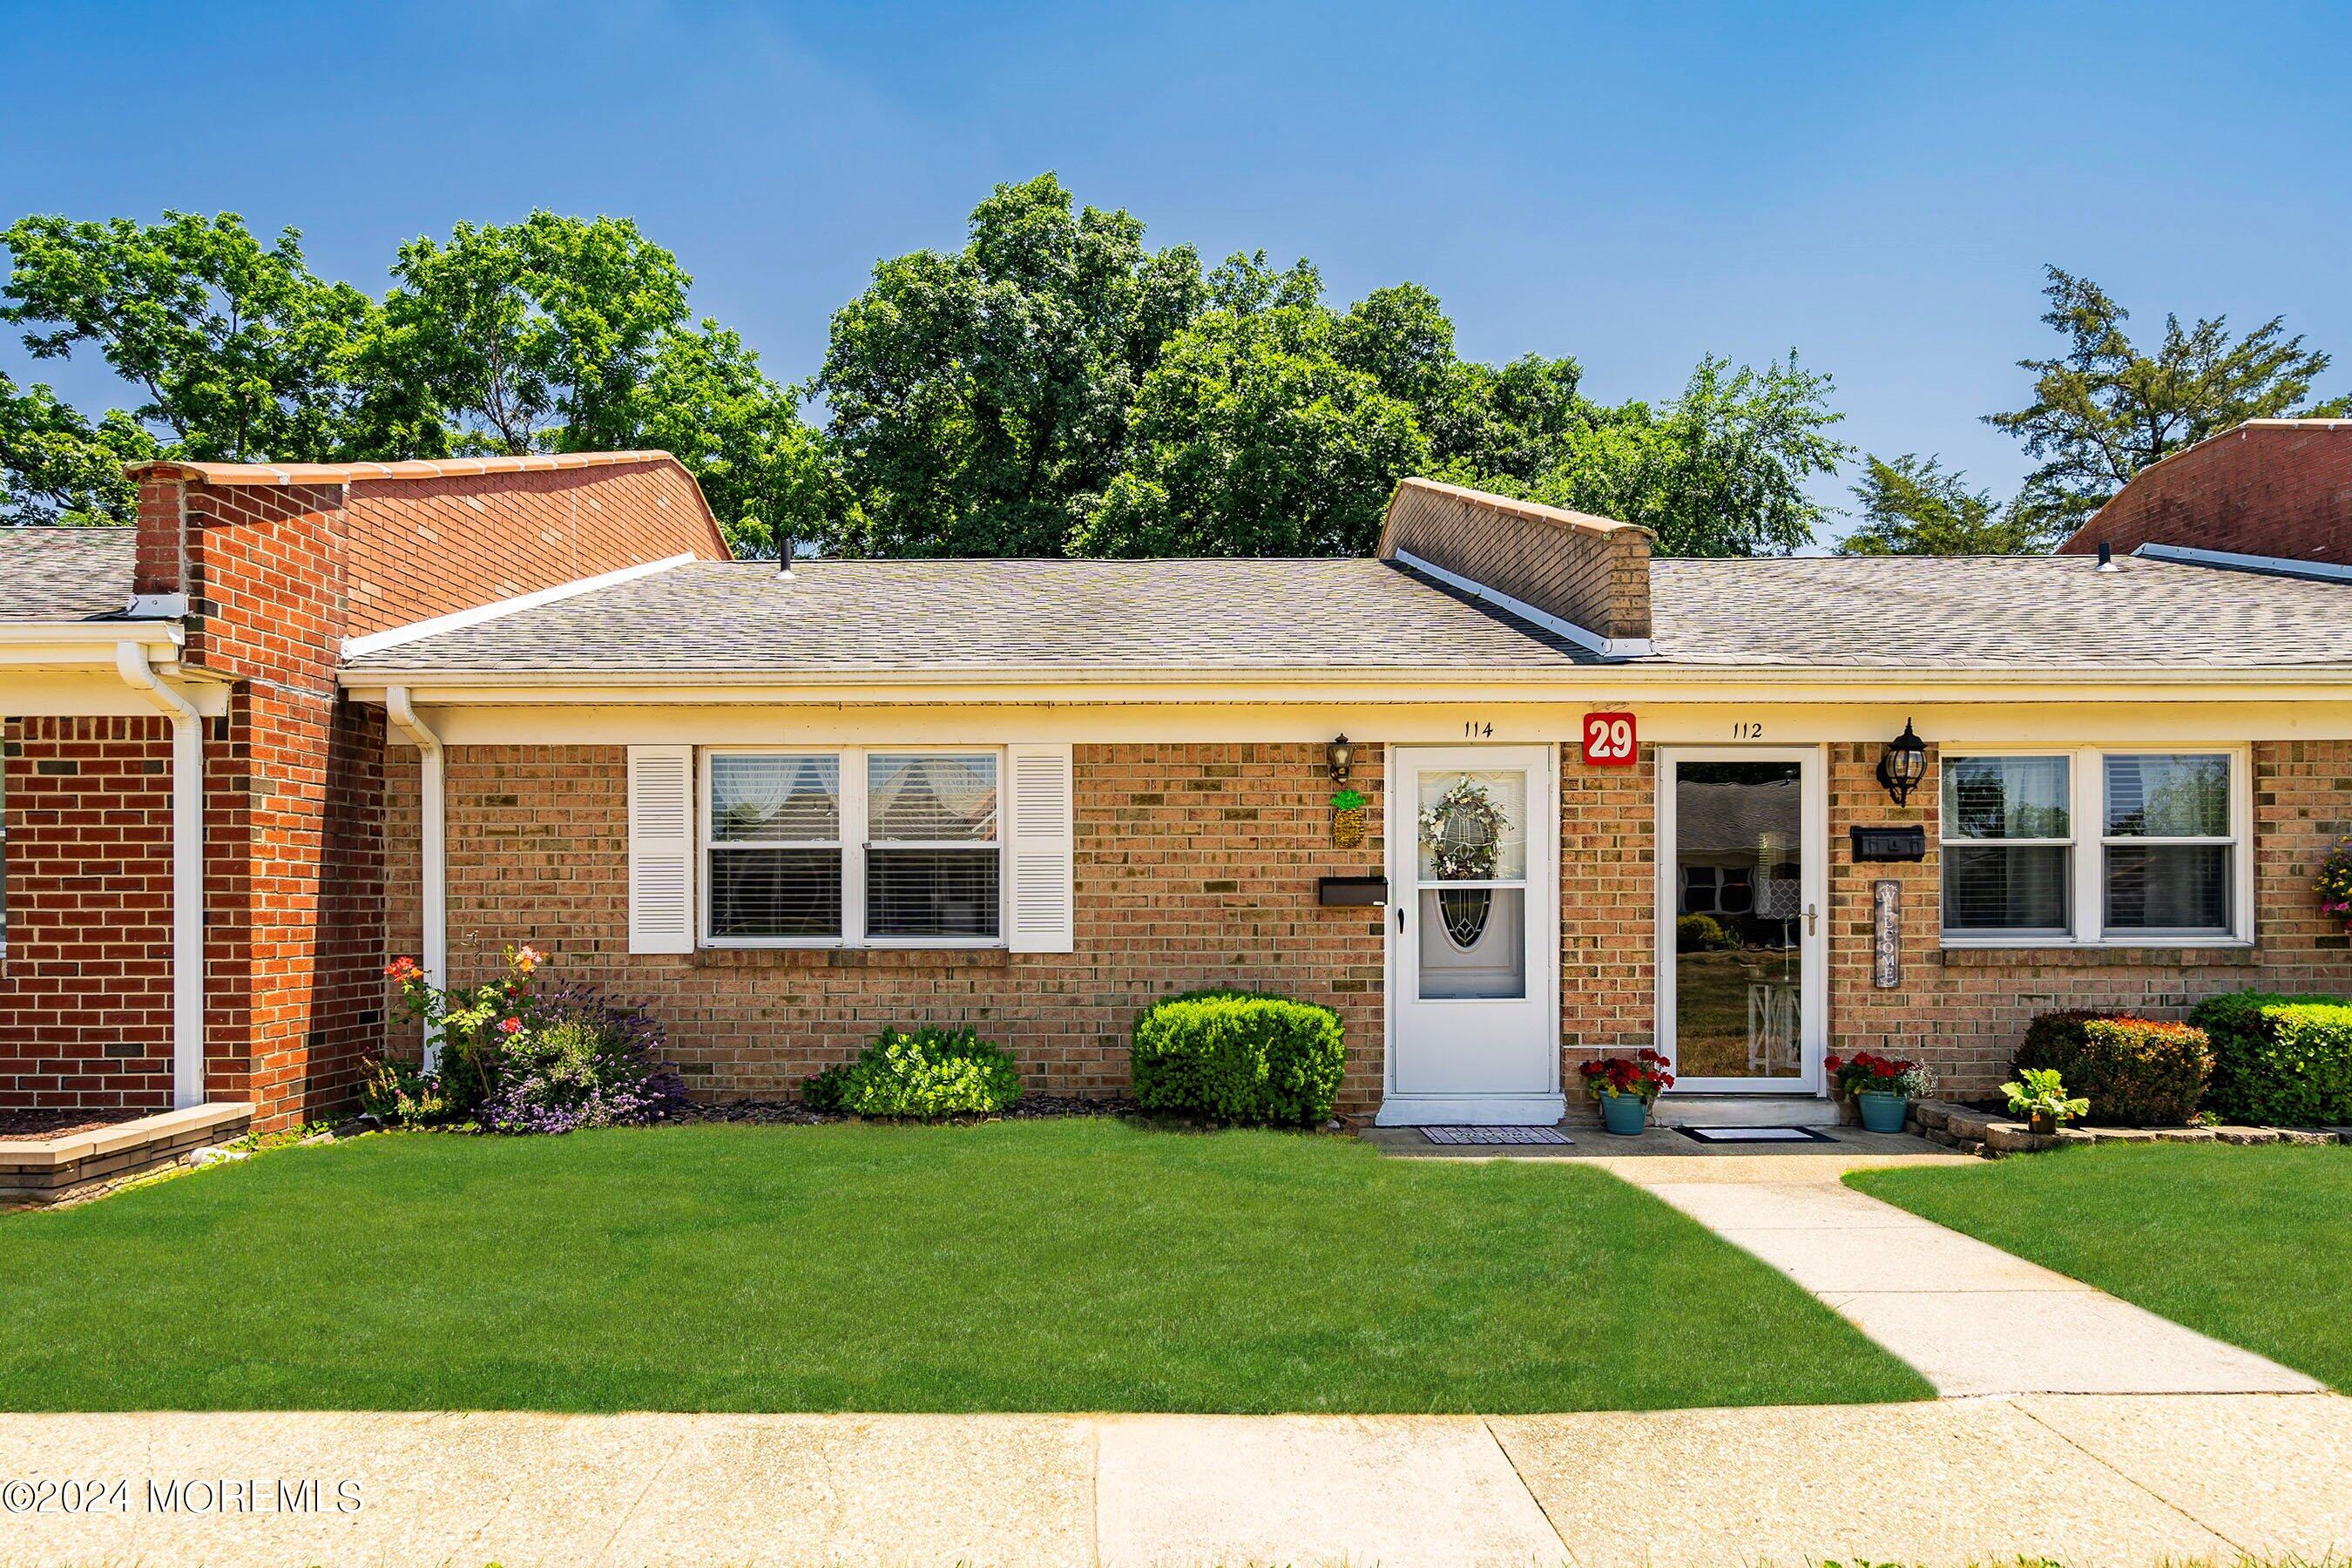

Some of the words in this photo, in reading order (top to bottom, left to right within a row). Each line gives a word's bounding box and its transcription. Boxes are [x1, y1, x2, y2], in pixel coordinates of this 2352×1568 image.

[1465, 721, 1493, 738] 114
[1589, 720, 1632, 757] 29
[1734, 723, 1761, 739] 112
[1882, 891, 1895, 978] WELCOME
